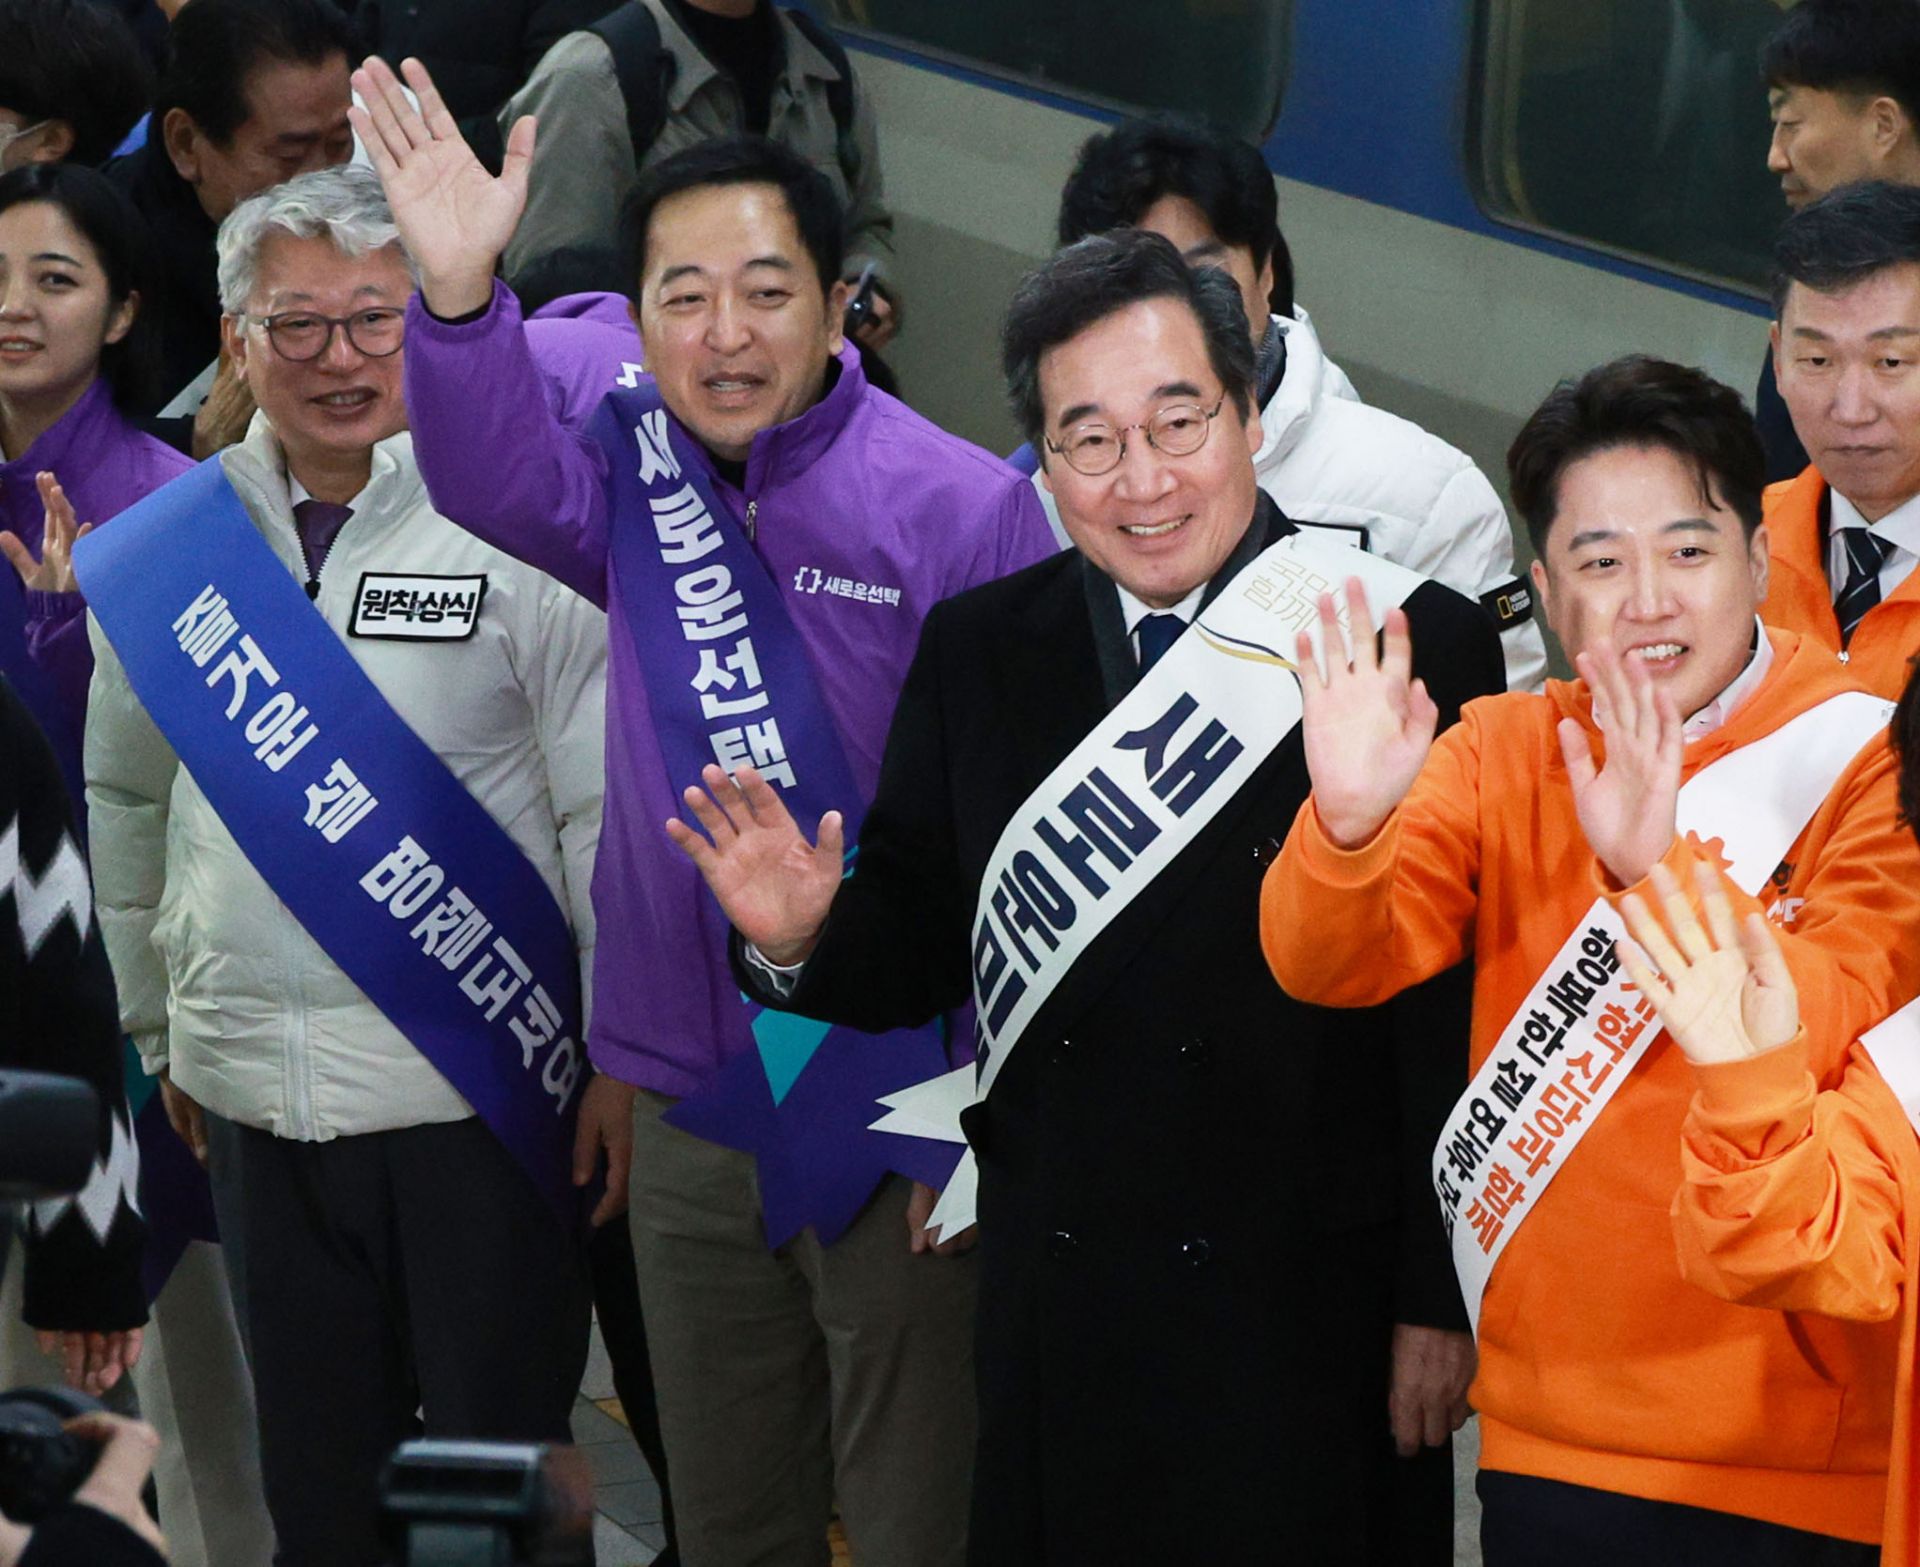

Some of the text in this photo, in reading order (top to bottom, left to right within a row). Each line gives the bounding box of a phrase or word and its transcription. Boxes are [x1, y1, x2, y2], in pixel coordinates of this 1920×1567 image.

[635, 408, 797, 788] 새로운선택
[823, 576, 901, 607] 새로운선택
[172, 584, 580, 1115] 즐거운 설 명절되세요
[974, 692, 1244, 1095] 새로운미
[1518, 926, 1621, 1068] 행복한
[1447, 1096, 1507, 1182] 연휴
[1490, 1060, 1535, 1112] 설
[1465, 1163, 1525, 1253] 함께
